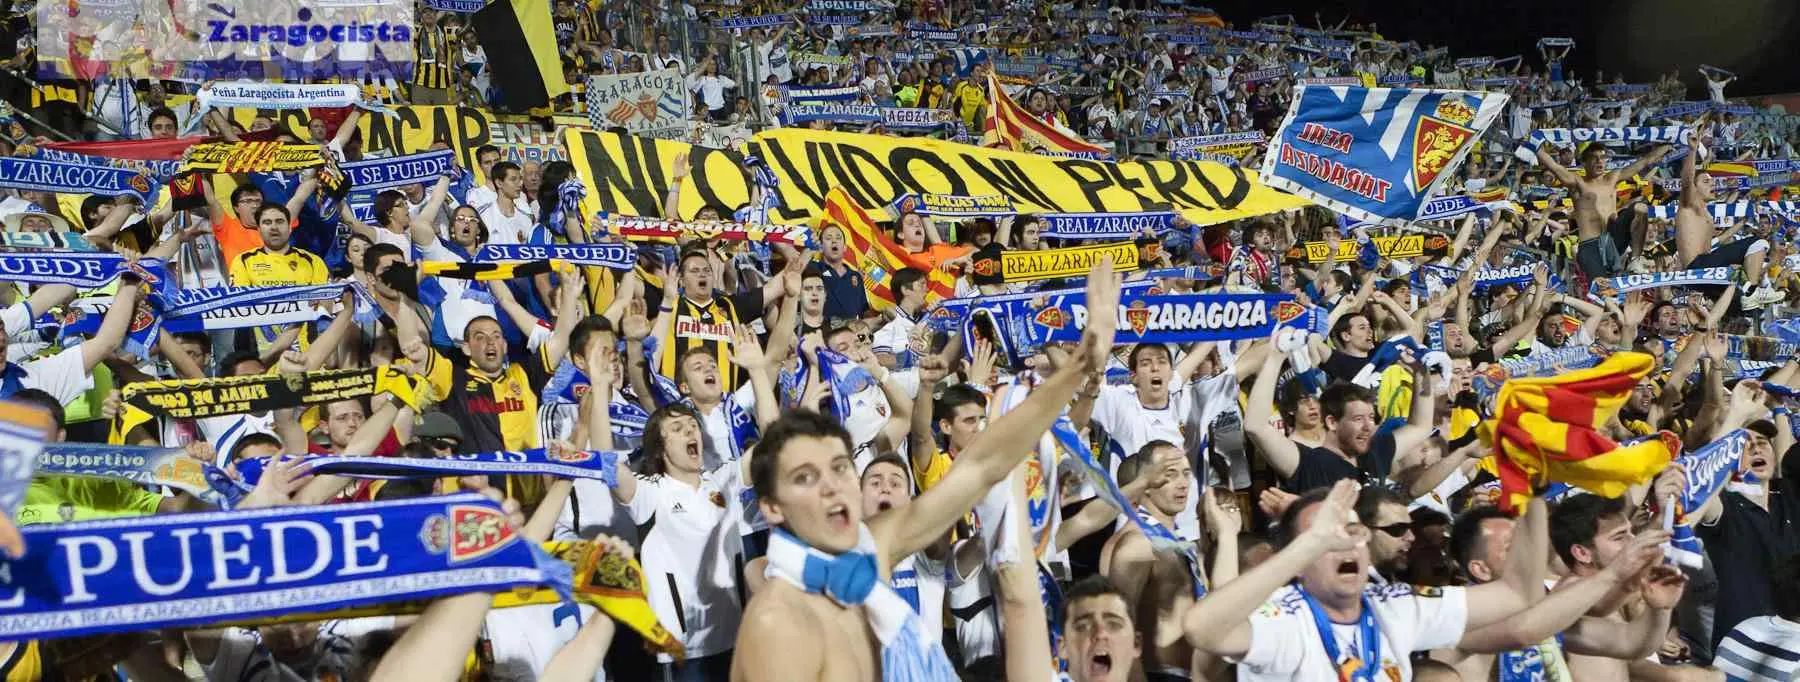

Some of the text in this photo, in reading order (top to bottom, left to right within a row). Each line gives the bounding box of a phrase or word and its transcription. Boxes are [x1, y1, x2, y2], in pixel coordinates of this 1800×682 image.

[211, 86, 346, 100] Peña Zaragocista Argentina
[597, 75, 682, 104] ZARAGOZA
[793, 104, 881, 117] REAL ZARAGOZA
[887, 110, 931, 123] AGOZA
[13, 160, 121, 191] ZARAGOZA
[362, 165, 384, 184] SE
[1056, 216, 1167, 234] REAL ZARAGOZA
[488, 245, 634, 263] SI SE PUEDE
[1006, 256, 1049, 275] REAL
[1472, 261, 1537, 282] ZARAGOZ
[1615, 267, 1728, 289] LOS DEL 28
[1070, 303, 1133, 332] RL
[1148, 299, 1267, 332] ZARAGOZA
[1428, 321, 1442, 351] REA
[38, 451, 146, 470] deportivo
[57, 514, 390, 605] PUEDE
